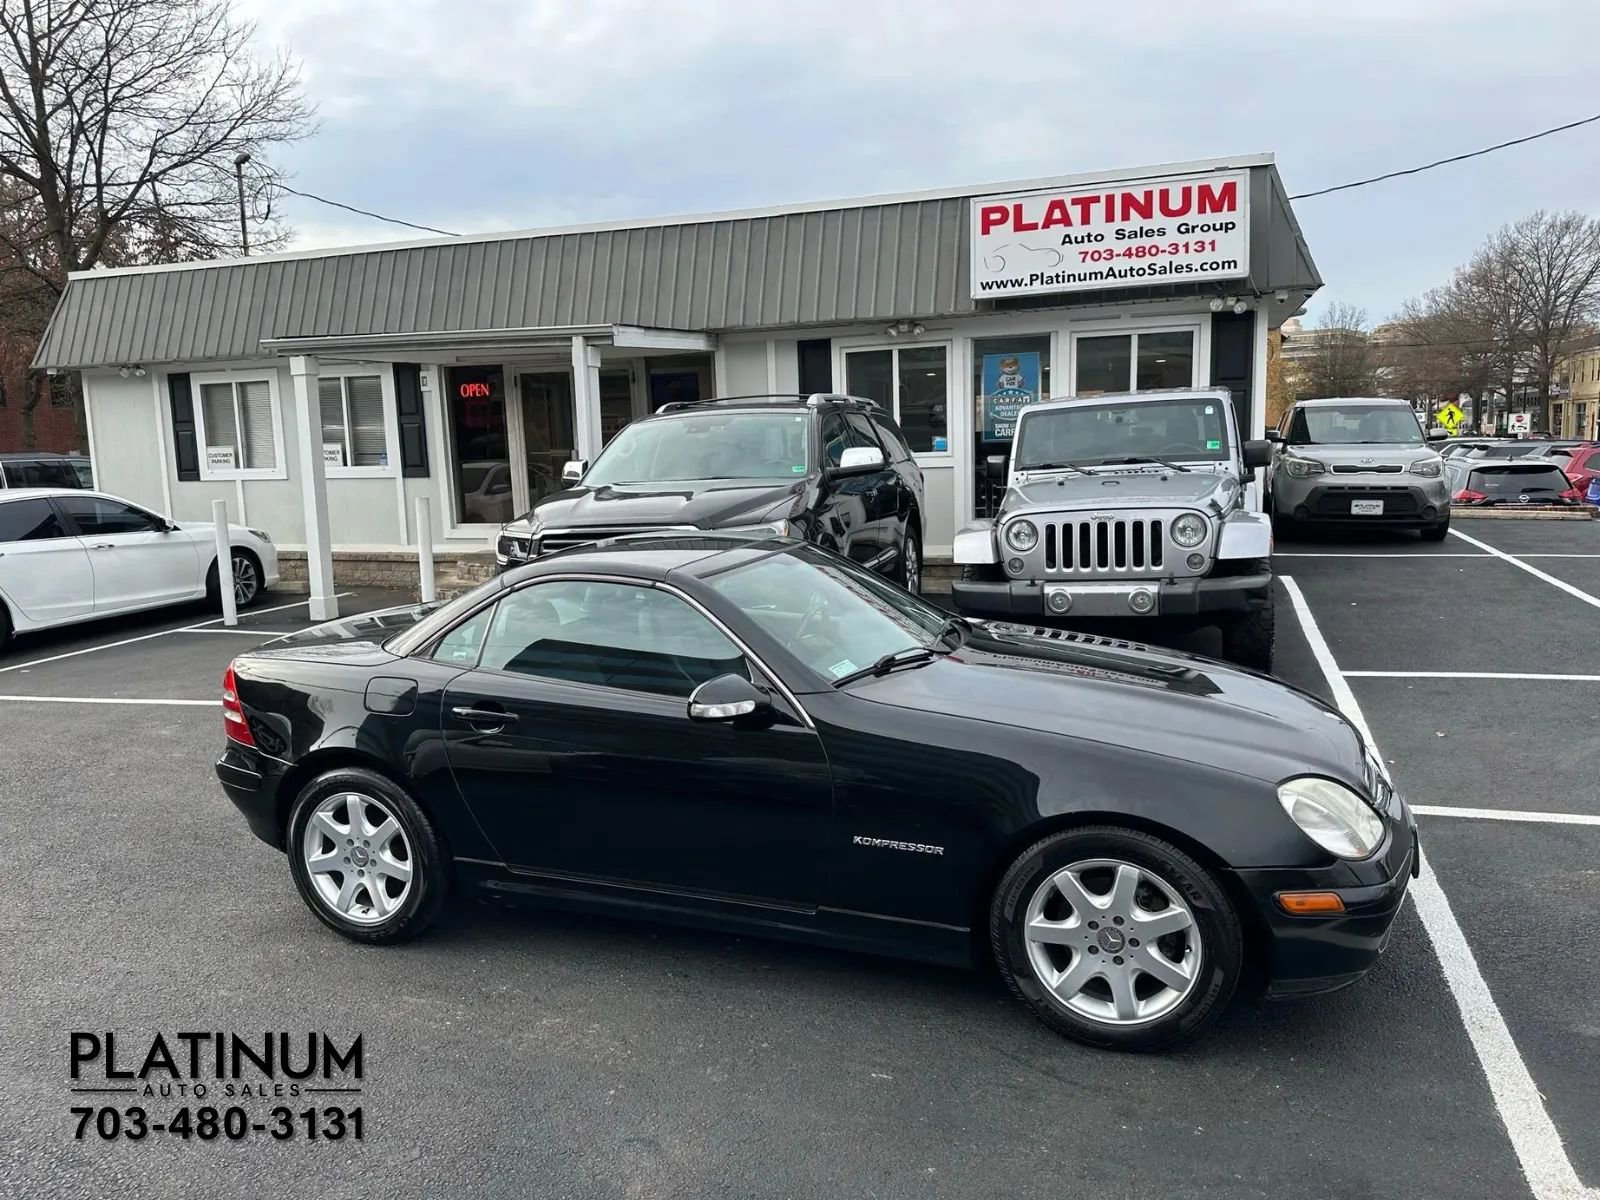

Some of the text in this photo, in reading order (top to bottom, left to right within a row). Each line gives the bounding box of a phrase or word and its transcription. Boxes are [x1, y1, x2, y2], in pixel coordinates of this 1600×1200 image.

[981, 181, 1237, 235] PLATINUM
[1061, 221, 1236, 245] Auto Sales Group
[1078, 239, 1216, 263] 703-480-3131
[980, 259, 1237, 290] www.PlatinumAutoSales.com
[460, 383, 489, 398] OPEN
[993, 396, 1030, 404] CARFAX
[995, 428, 1016, 437] CARF
[853, 836, 944, 855] KOMPRESSOR
